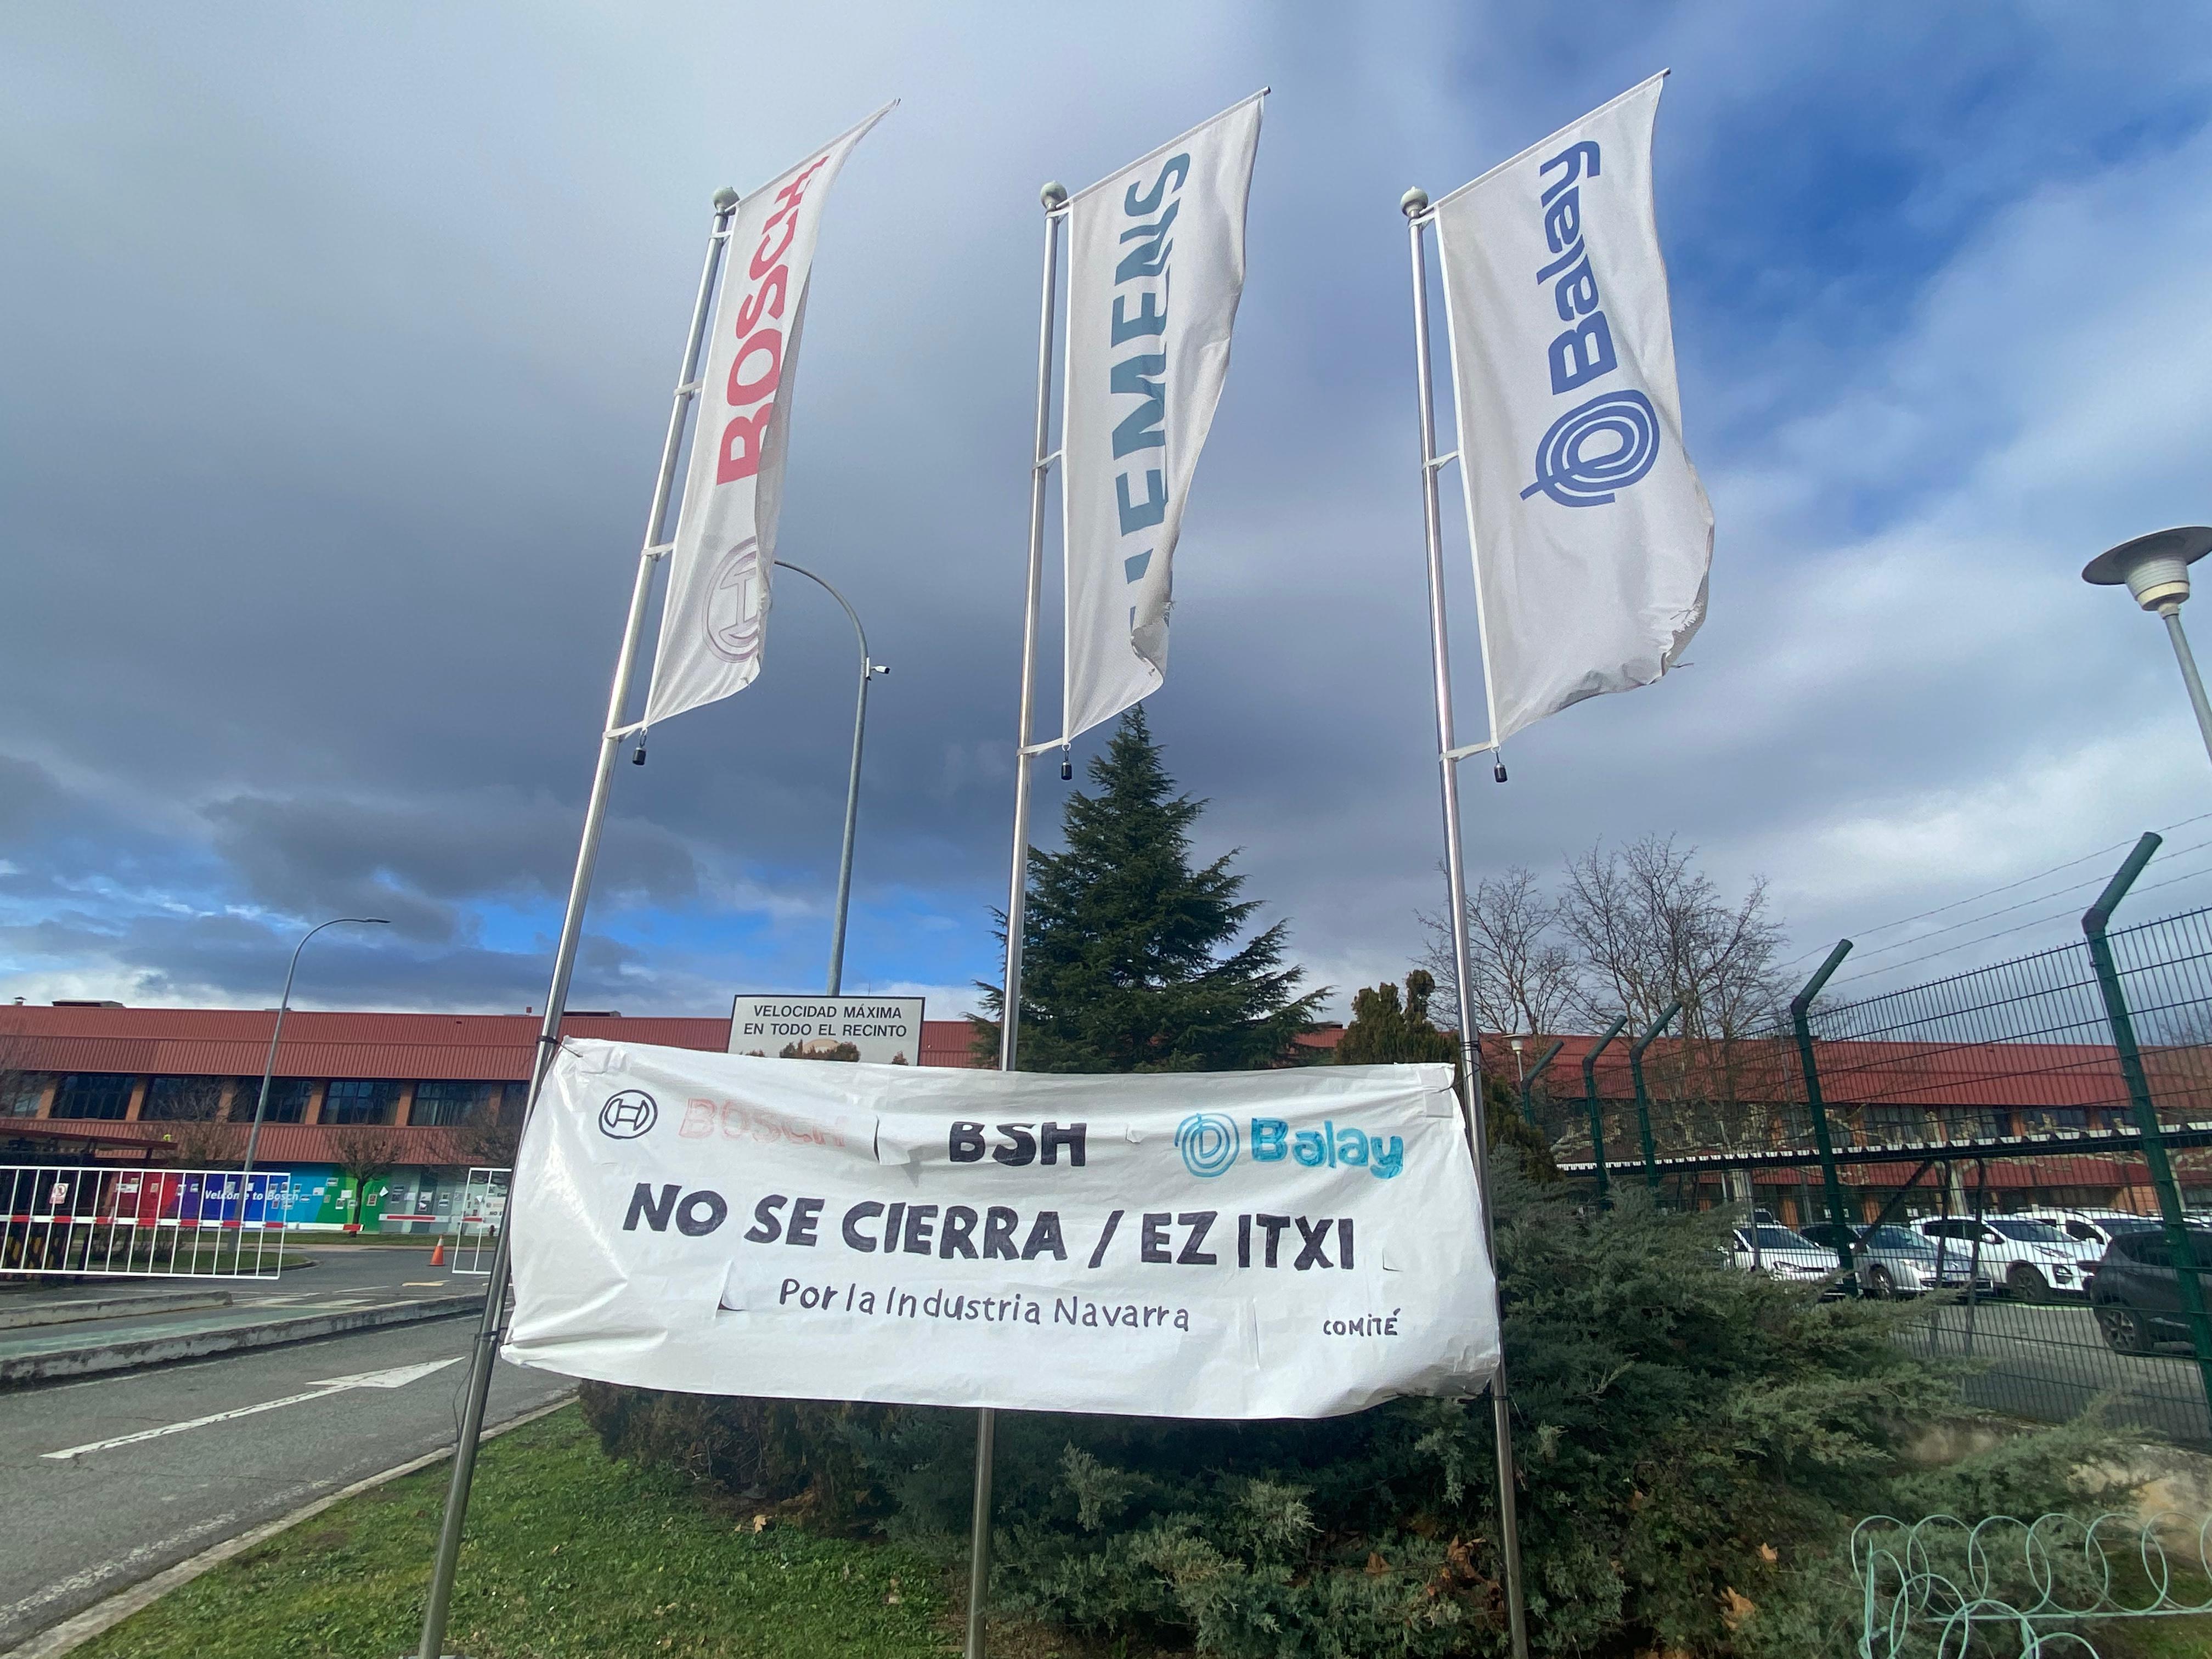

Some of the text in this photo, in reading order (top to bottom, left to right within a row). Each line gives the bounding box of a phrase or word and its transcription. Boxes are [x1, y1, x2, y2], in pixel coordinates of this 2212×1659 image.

[1537, 140, 1618, 395] Balay
[716, 155, 830, 486] BOSCH
[743, 1023, 907, 1037] EN TODO EL RECINTO
[754, 1003, 902, 1019] VELOCIDAD MÁXIMA
[949, 1121, 1087, 1167] BSH
[1251, 1117, 1404, 1179] Balay
[253, 1192, 263, 1200] to
[623, 1182, 1354, 1271] NO SE CIERRA / EZ ITXI
[779, 1278, 1189, 1332] Por la Industria Navarra
